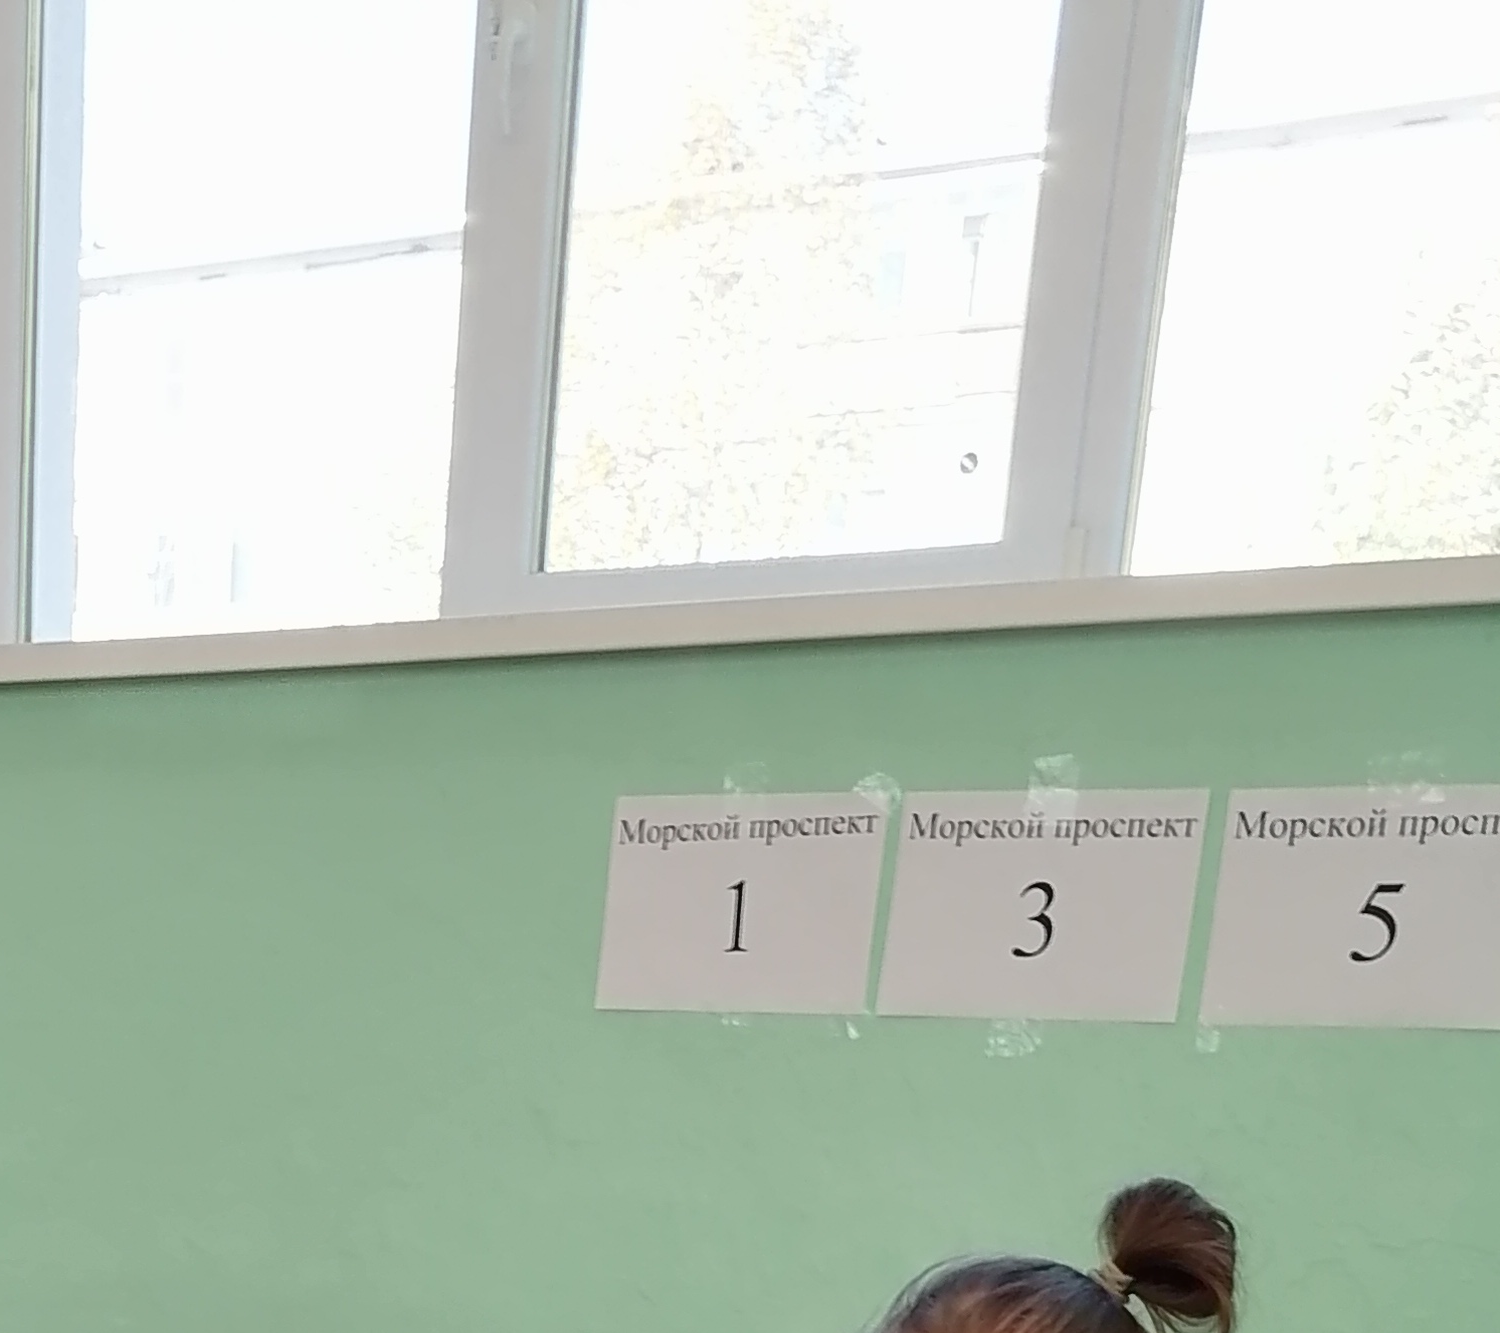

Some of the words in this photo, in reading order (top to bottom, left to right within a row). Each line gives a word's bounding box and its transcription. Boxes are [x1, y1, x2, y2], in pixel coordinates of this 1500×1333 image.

[618, 814, 741, 851] Морской
[748, 814, 880, 846] проспект
[909, 812, 1043, 848] Морской
[1054, 817, 1199, 847] проспект
[1235, 808, 1387, 847] Морской
[724, 880, 748, 953] 1
[1012, 881, 1054, 958] 3
[1349, 883, 1406, 962] 5
